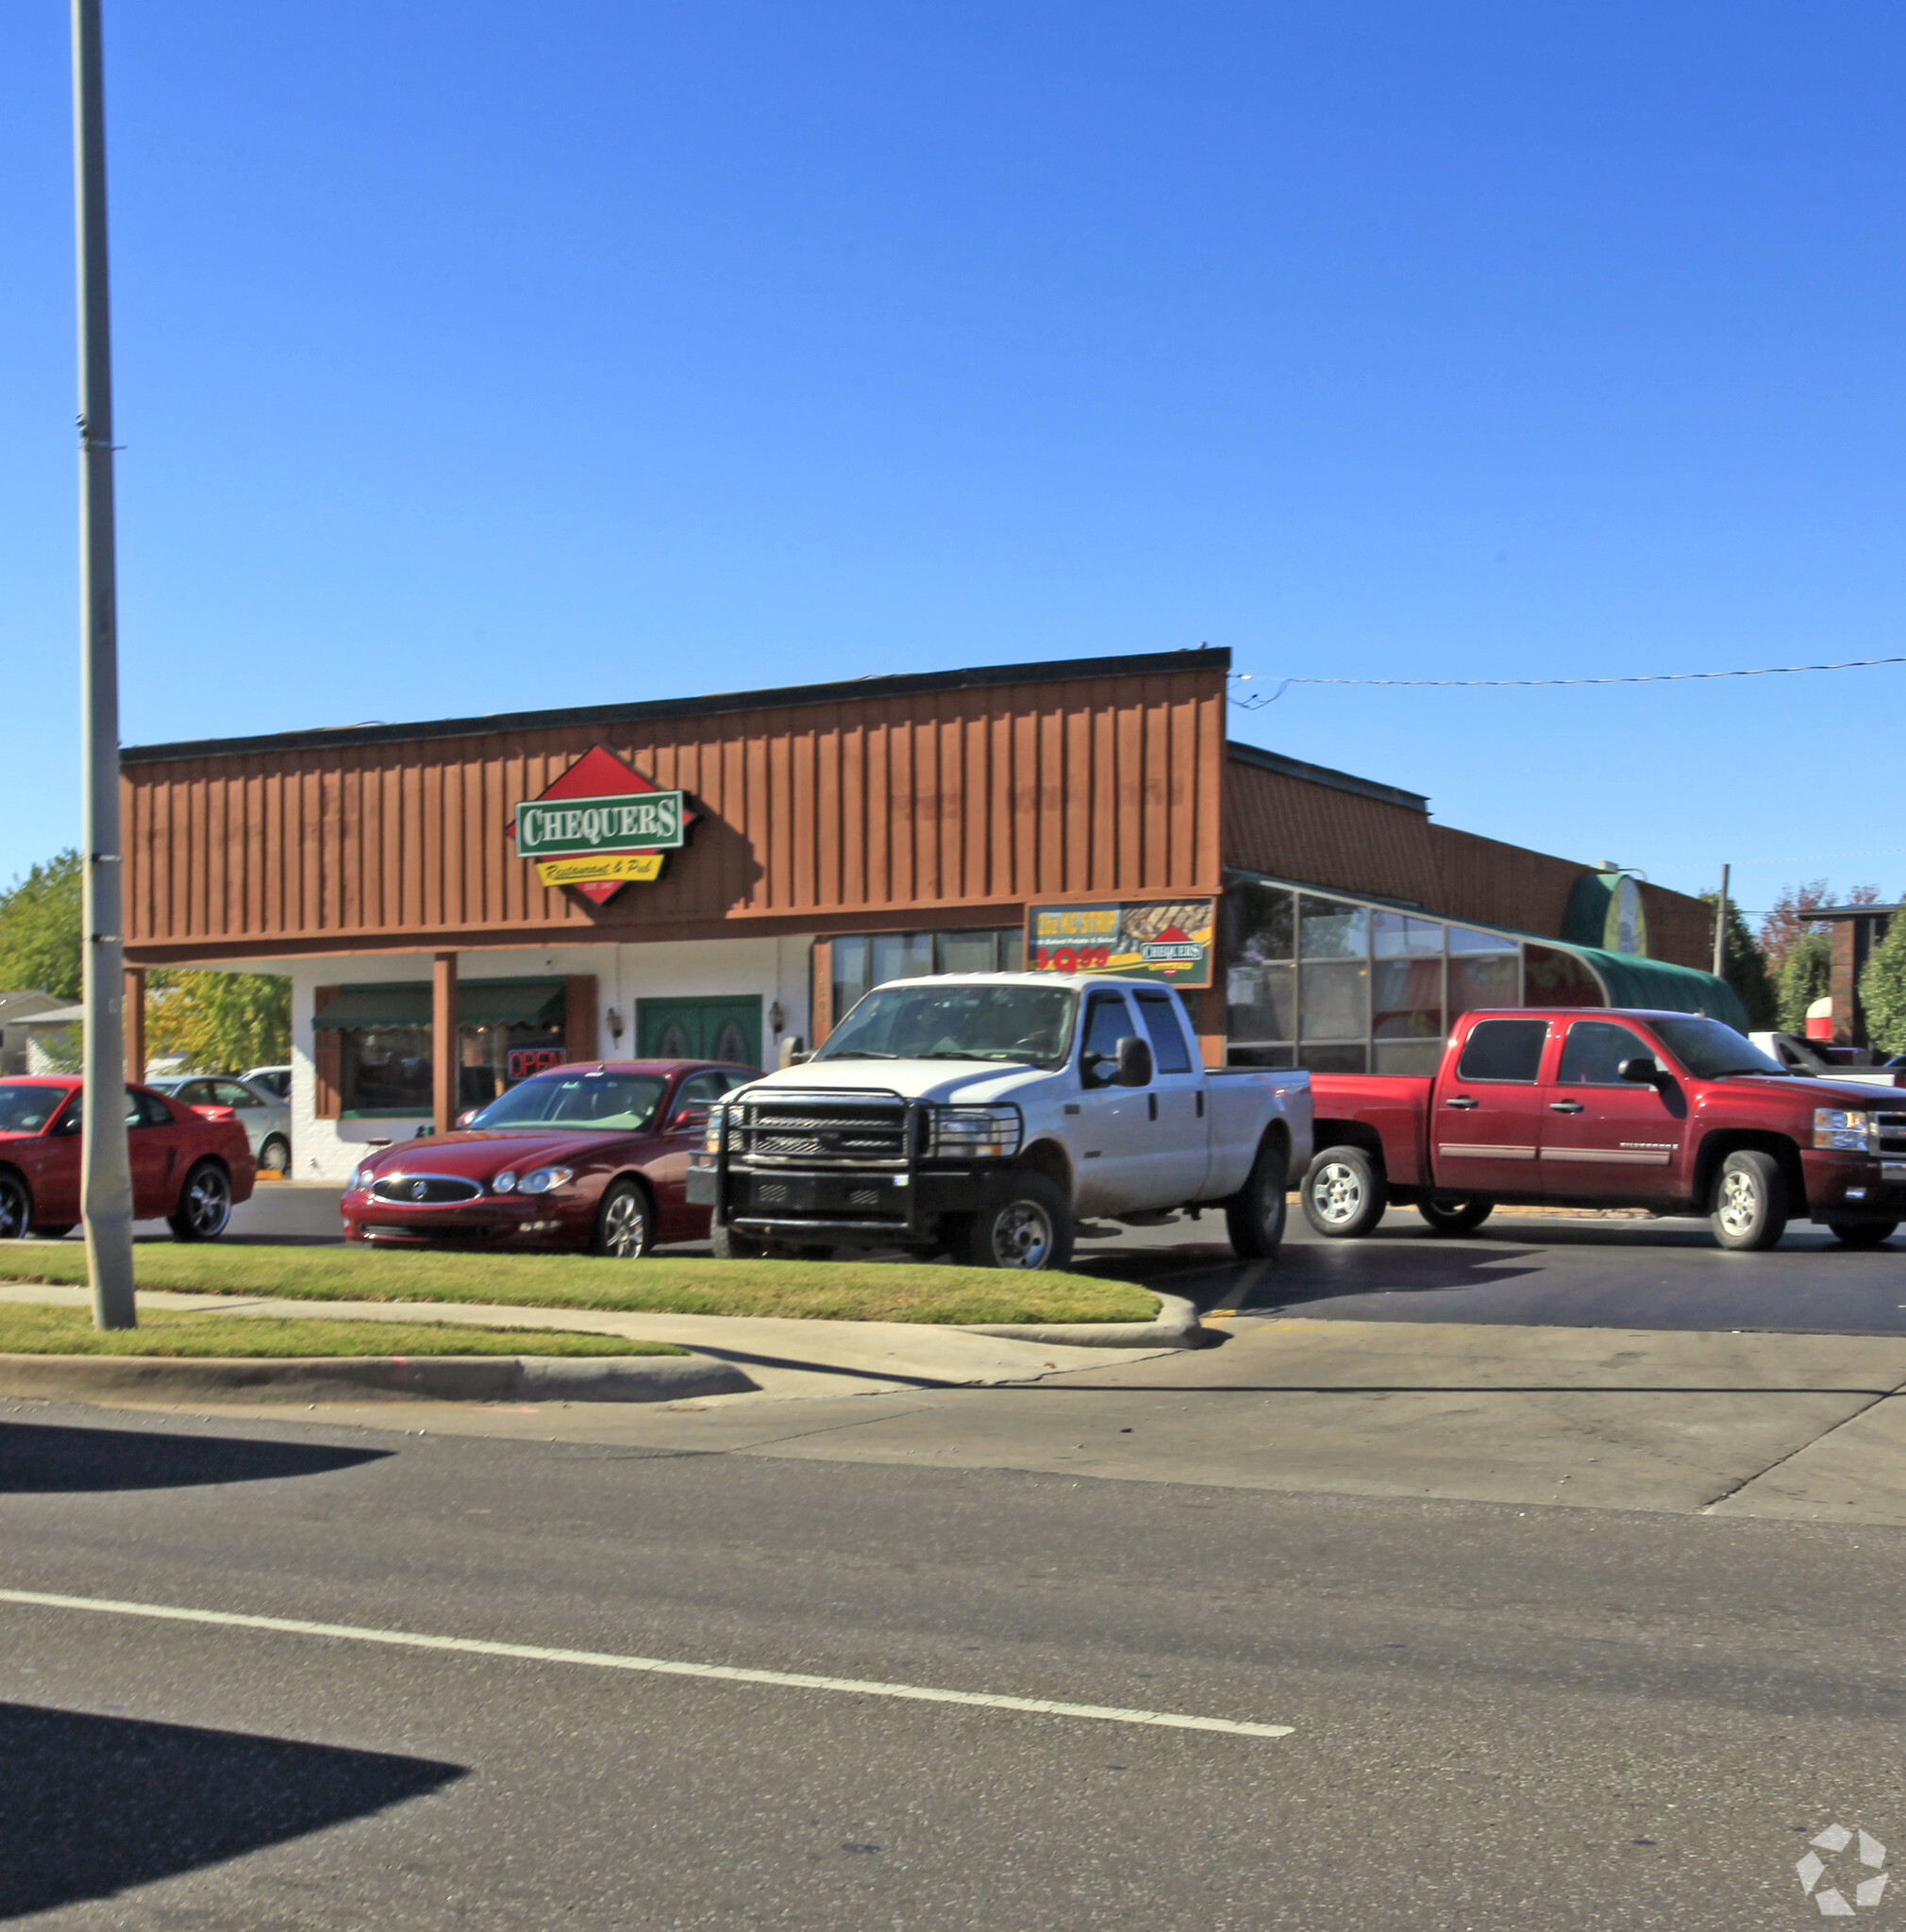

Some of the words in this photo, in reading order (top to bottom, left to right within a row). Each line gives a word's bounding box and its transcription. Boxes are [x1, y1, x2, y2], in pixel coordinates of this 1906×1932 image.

[523, 799, 676, 846] CHEQUERS
[627, 859, 654, 874] Pub
[510, 1051, 564, 1077] OPEN
